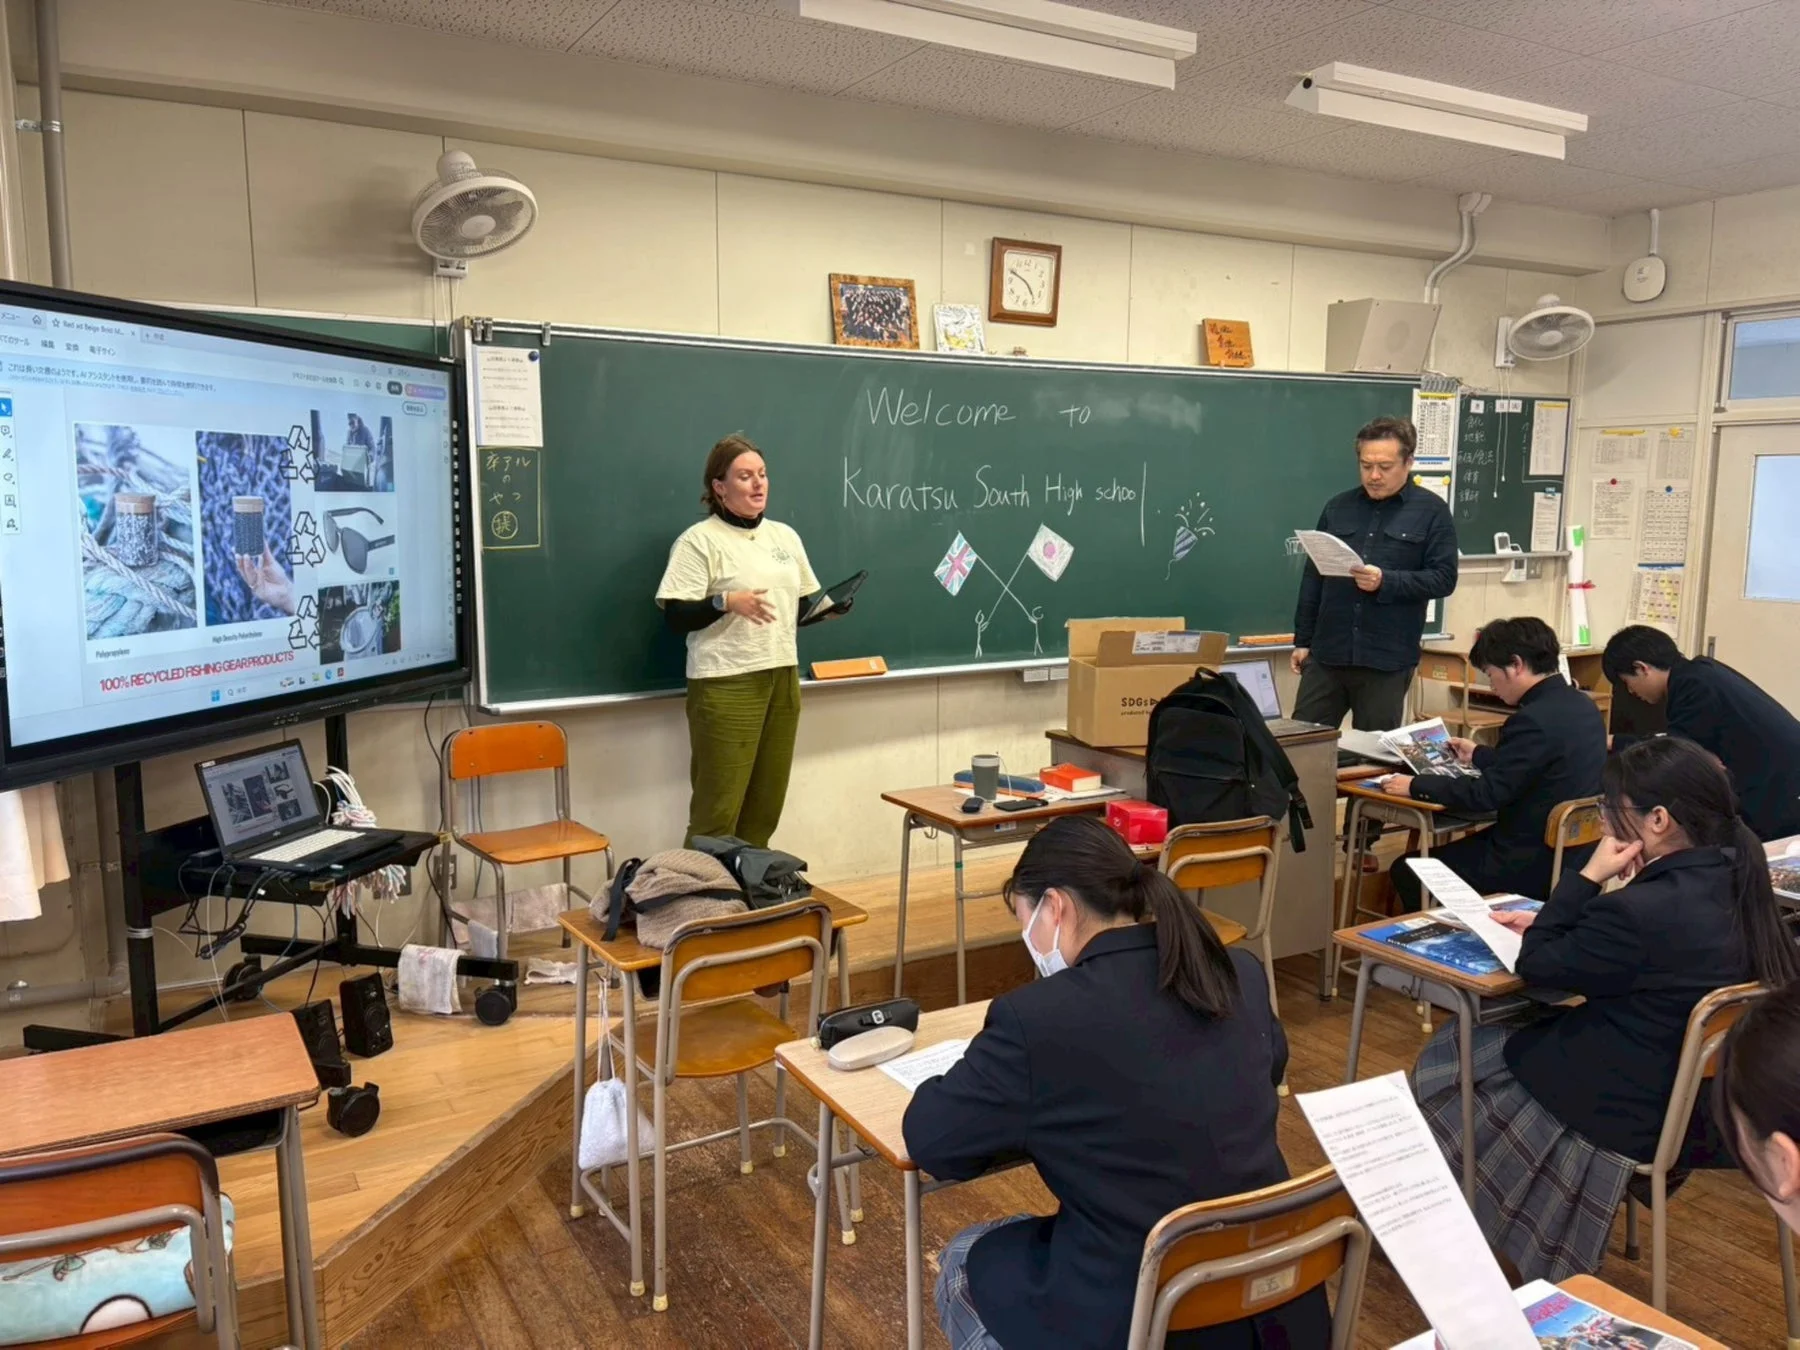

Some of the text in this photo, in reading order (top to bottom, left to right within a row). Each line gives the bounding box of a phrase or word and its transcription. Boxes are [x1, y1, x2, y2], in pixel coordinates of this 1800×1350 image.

[866, 386, 1016, 427] Welcome
[843, 456, 1147, 546] Karatsu South High school
[100, 650, 295, 692] 100% RECYCLED FISHING GEAR PRODUCTS
[1121, 697, 1149, 707] SDGs
